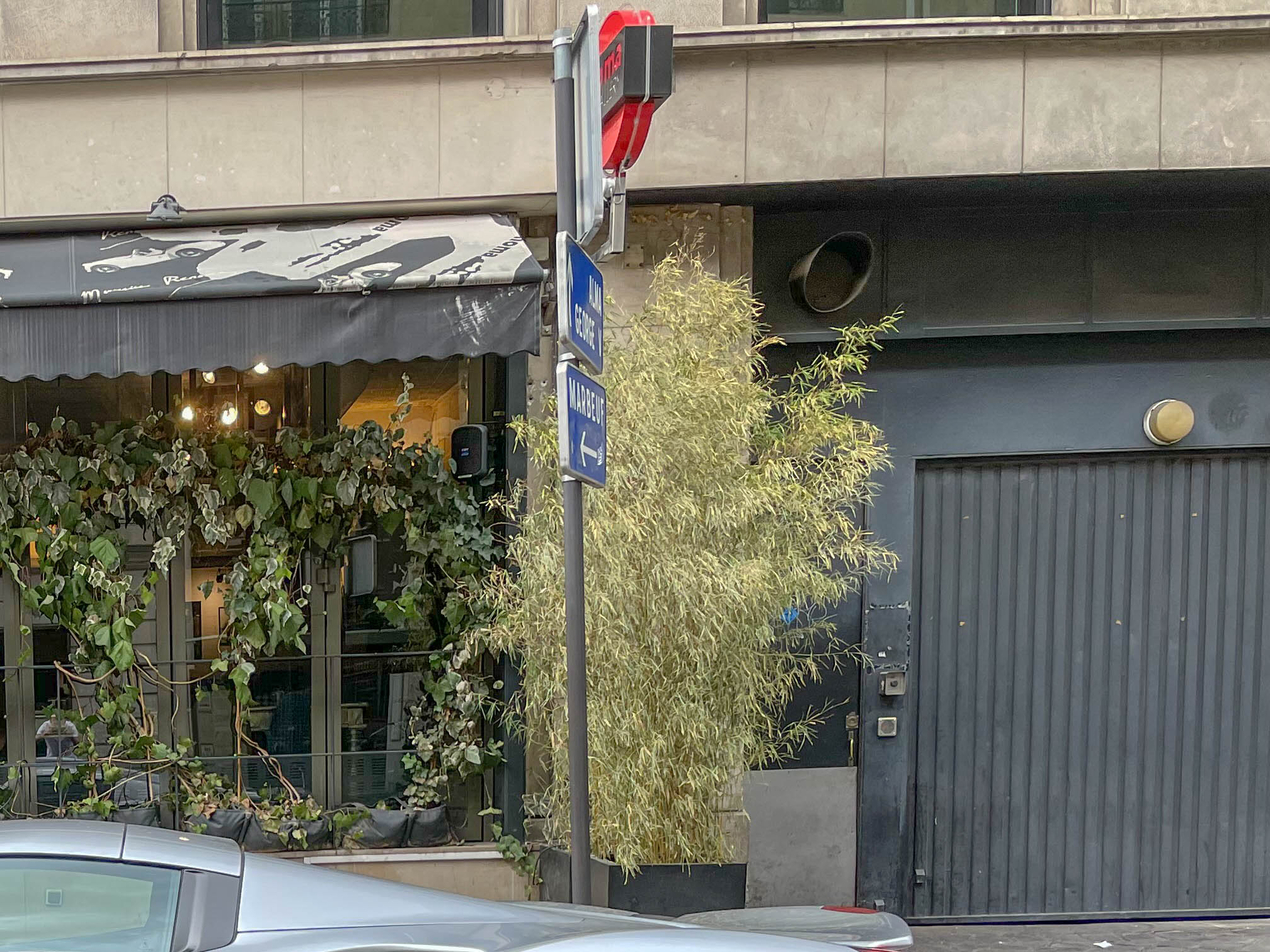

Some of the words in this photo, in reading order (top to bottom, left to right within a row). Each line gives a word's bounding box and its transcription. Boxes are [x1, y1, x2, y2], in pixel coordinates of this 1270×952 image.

[600, 43, 622, 86] ma
[589, 275, 602, 316] ALMA
[575, 303, 595, 350] GEORGE
[598, 327, 602, 357] V
[569, 377, 604, 427] MARBEUF
